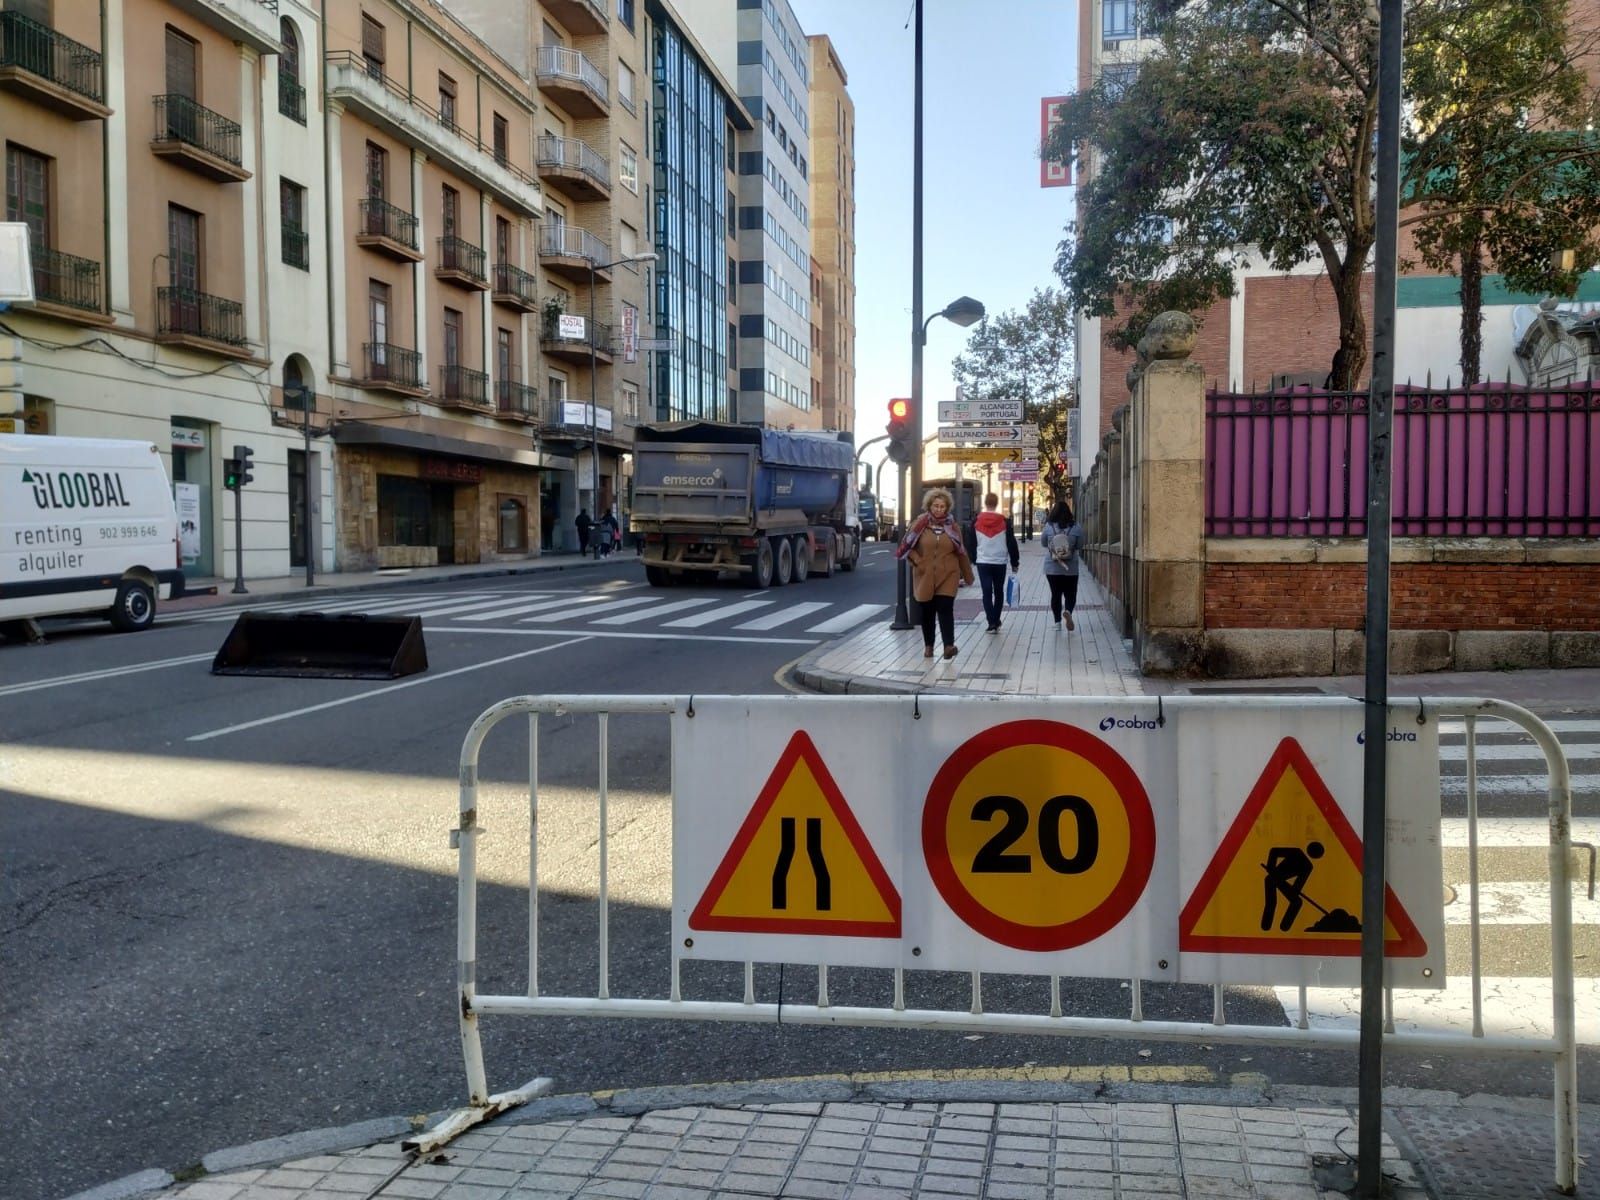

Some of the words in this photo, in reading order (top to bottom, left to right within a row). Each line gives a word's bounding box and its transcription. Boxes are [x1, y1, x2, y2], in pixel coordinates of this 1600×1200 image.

[561, 317, 582, 327] HOSTAL
[624, 309, 633, 361] HOSTAL
[33, 472, 130, 509] GLOOBAL
[663, 475, 714, 486] emserco
[15, 525, 82, 546] renting
[99, 527, 118, 539] 902
[121, 527, 138, 538] 999
[140, 526, 157, 537] 646
[19, 552, 84, 575] alquiler
[1117, 715, 1156, 729] cobra
[1386, 727, 1416, 741] obra
[971, 795, 1098, 874] 20
